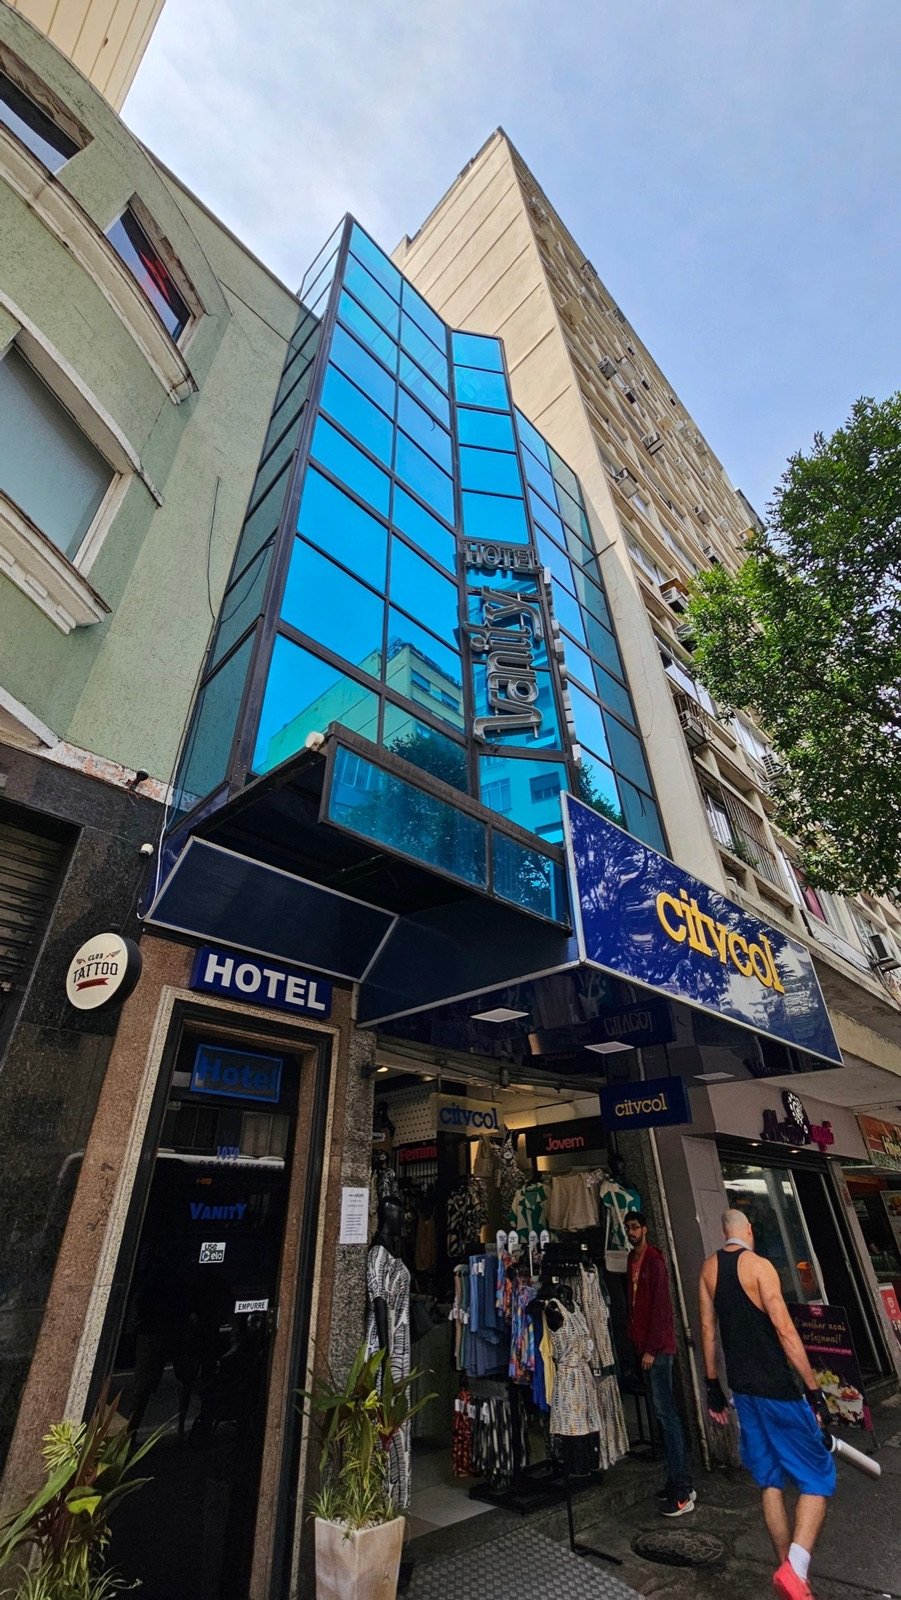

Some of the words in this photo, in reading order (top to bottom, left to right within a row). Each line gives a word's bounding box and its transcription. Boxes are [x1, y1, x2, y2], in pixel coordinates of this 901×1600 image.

[463, 542, 542, 575] HOTEL
[464, 586, 544, 740] Vanity
[655, 888, 784, 994] citycol
[88, 953, 103, 961] CLUB
[73, 961, 118, 983] TATTOO
[204, 953, 326, 1011] HOTEL
[199, 1054, 279, 1090] Hotel
[440, 1102, 499, 1130] citycol
[615, 1093, 668, 1117] citycol
[545, 1135, 584, 1152] Jovem
[238, 1301, 266, 1311] EMPURRE
